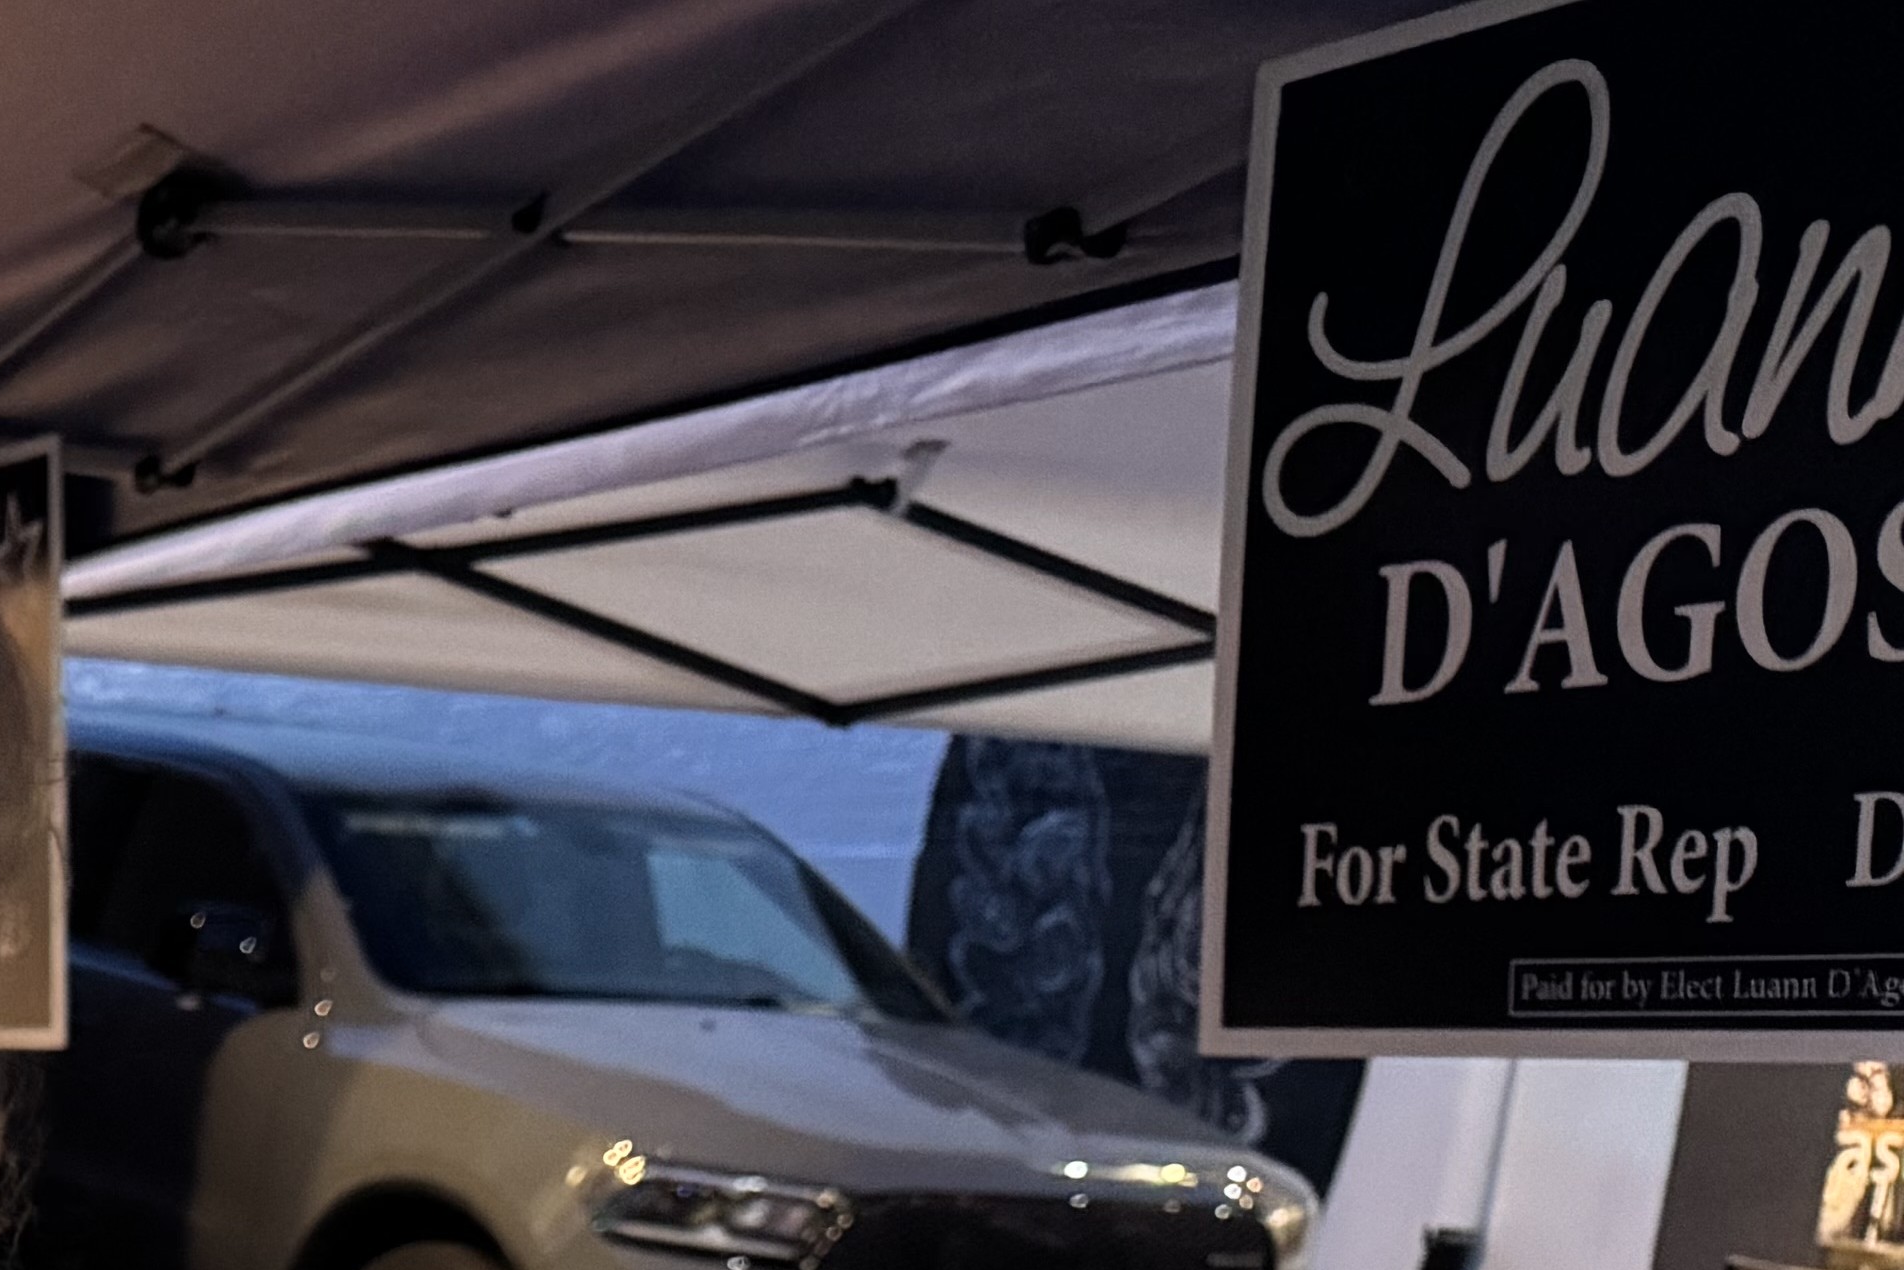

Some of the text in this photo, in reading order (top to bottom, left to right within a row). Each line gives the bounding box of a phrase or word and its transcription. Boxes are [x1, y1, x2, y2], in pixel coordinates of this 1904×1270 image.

[1262, 58, 1904, 537] Luan
[1298, 822, 1407, 907] For
[1423, 812, 1593, 904] State
[1611, 803, 1759, 923] Rep
[1521, 966, 1904, 1008] Paid for by Elect Luann D'Ag
